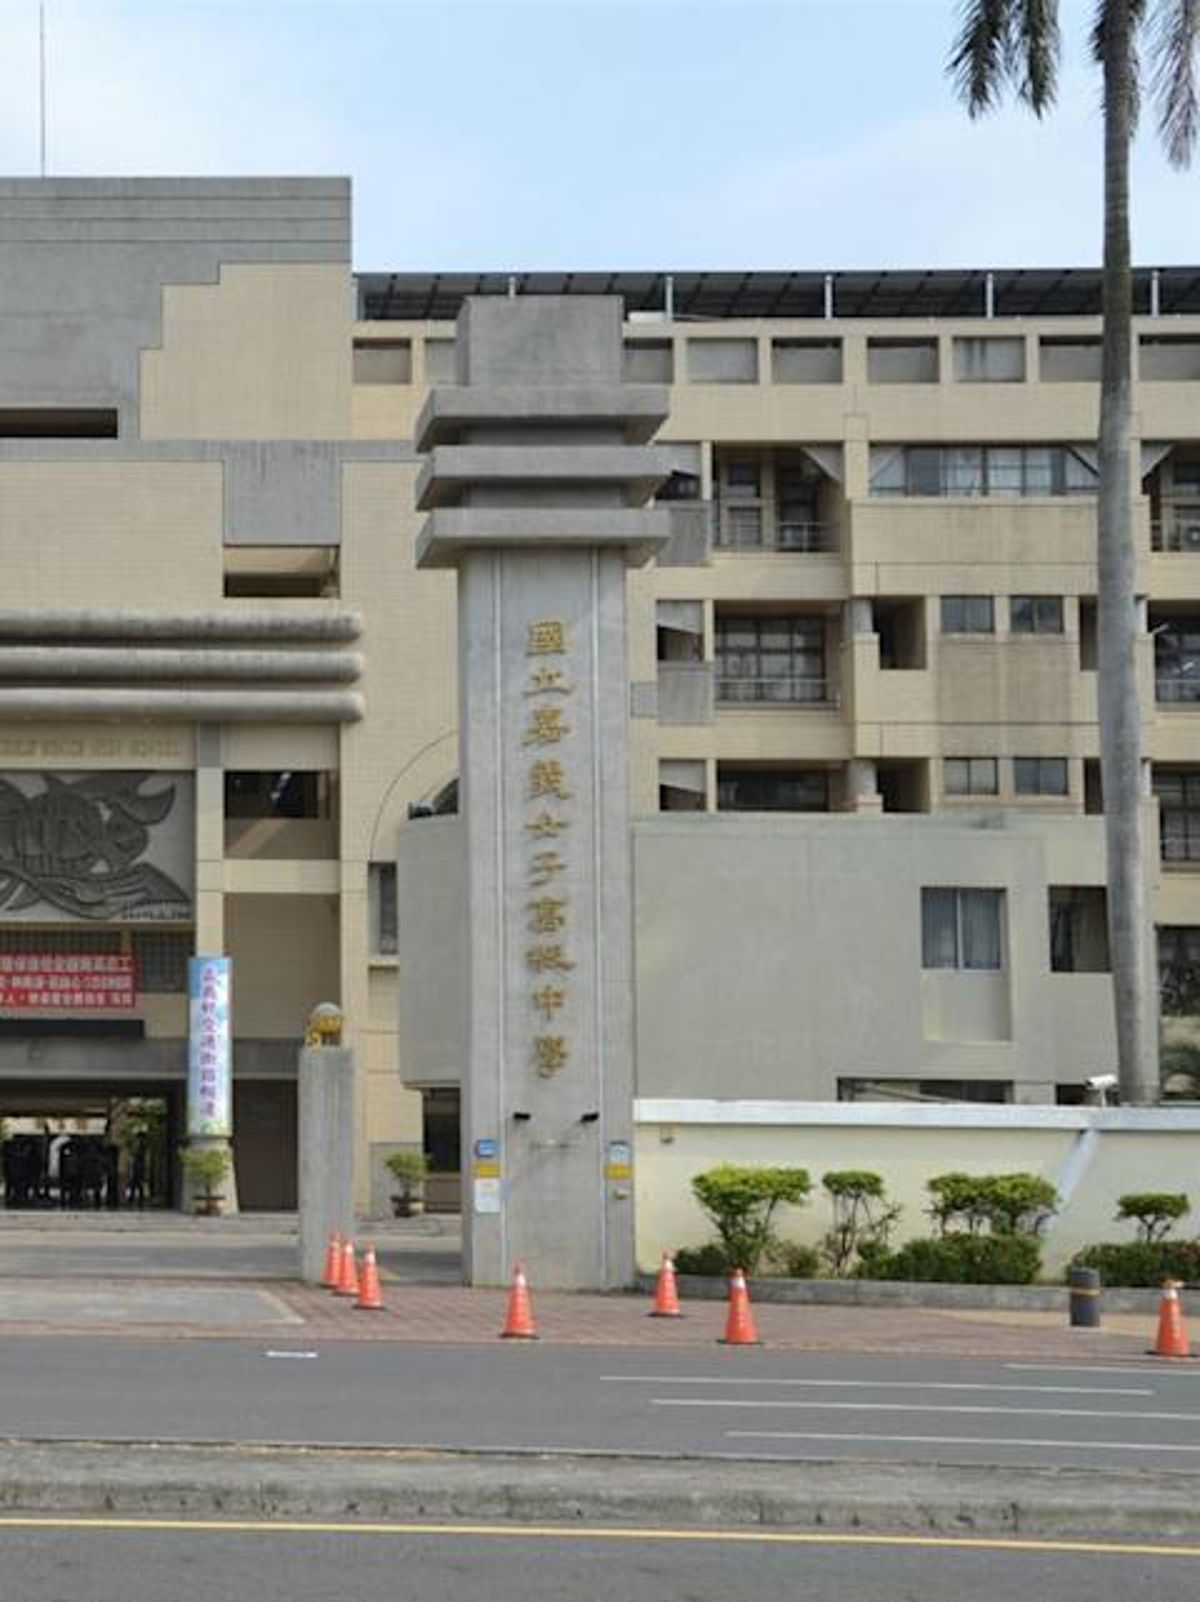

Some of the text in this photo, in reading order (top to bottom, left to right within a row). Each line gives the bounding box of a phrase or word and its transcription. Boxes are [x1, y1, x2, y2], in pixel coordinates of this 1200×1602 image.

[522, 620, 576, 1079] 國立嘉義女子高級中學
